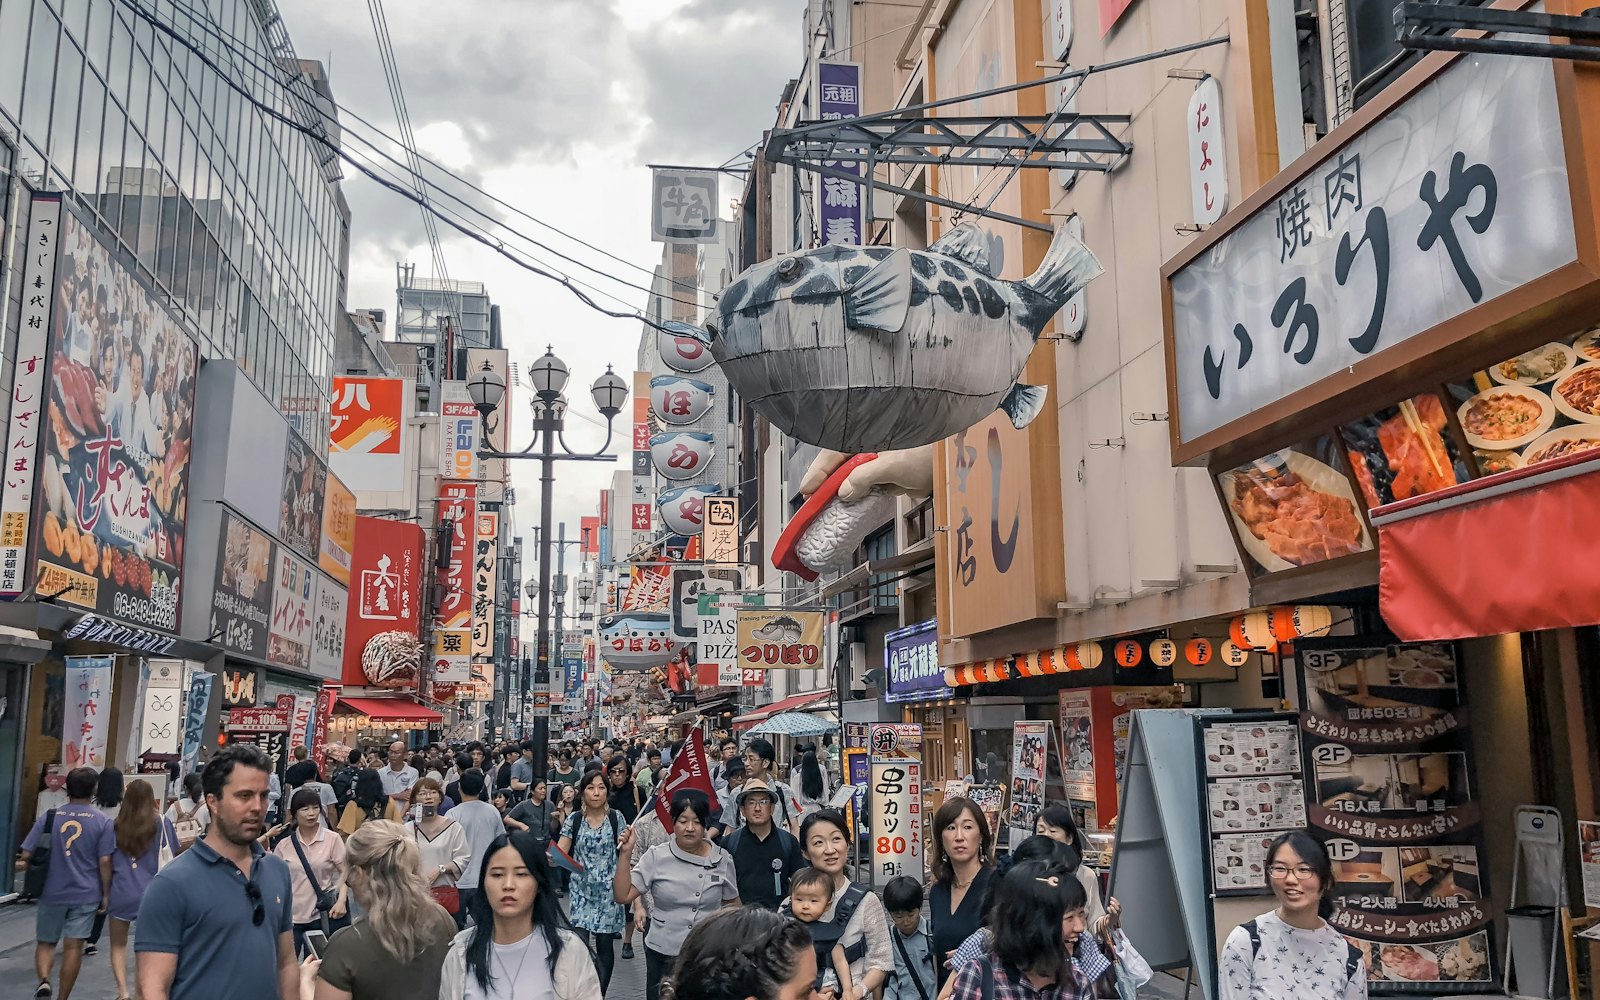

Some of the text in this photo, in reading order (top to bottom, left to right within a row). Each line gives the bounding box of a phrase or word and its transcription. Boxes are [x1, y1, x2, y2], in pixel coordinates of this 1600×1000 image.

[825, 87, 855, 102] 元祖
[1197, 103, 1215, 211] たよし
[662, 187, 709, 224] 牛角
[1276, 152, 1363, 264] 焼肉
[27, 218, 52, 329] つきじ喜代村
[1203, 151, 1498, 400] いろりや
[446, 405, 475, 414] 3F/4F
[8, 355, 43, 489] すしざんまい
[713, 505, 731, 520] 牛角
[2, 549, 17, 589] 道頓堀店
[473, 536, 498, 647] がんこ寿司
[114, 591, 176, 630] 06-6484-2280
[274, 589, 311, 637] レインボー
[702, 620, 738, 634] PAS
[443, 634, 461, 652] 薬
[725, 635, 735, 645] &
[741, 643, 819, 665] つりぼり
[1309, 654, 1336, 667] 3F
[743, 669, 762, 681] 2F
[1347, 707, 1422, 721] 団体50名様
[1317, 747, 1345, 761] 2F
[875, 766, 905, 833] 串カツ
[1334, 800, 1381, 813] 16人席
[1324, 814, 1459, 839] いい品質でこんなに安い
[876, 836, 906, 854] 80
[910, 819, 919, 857] たよし
[1327, 842, 1354, 857] 1F
